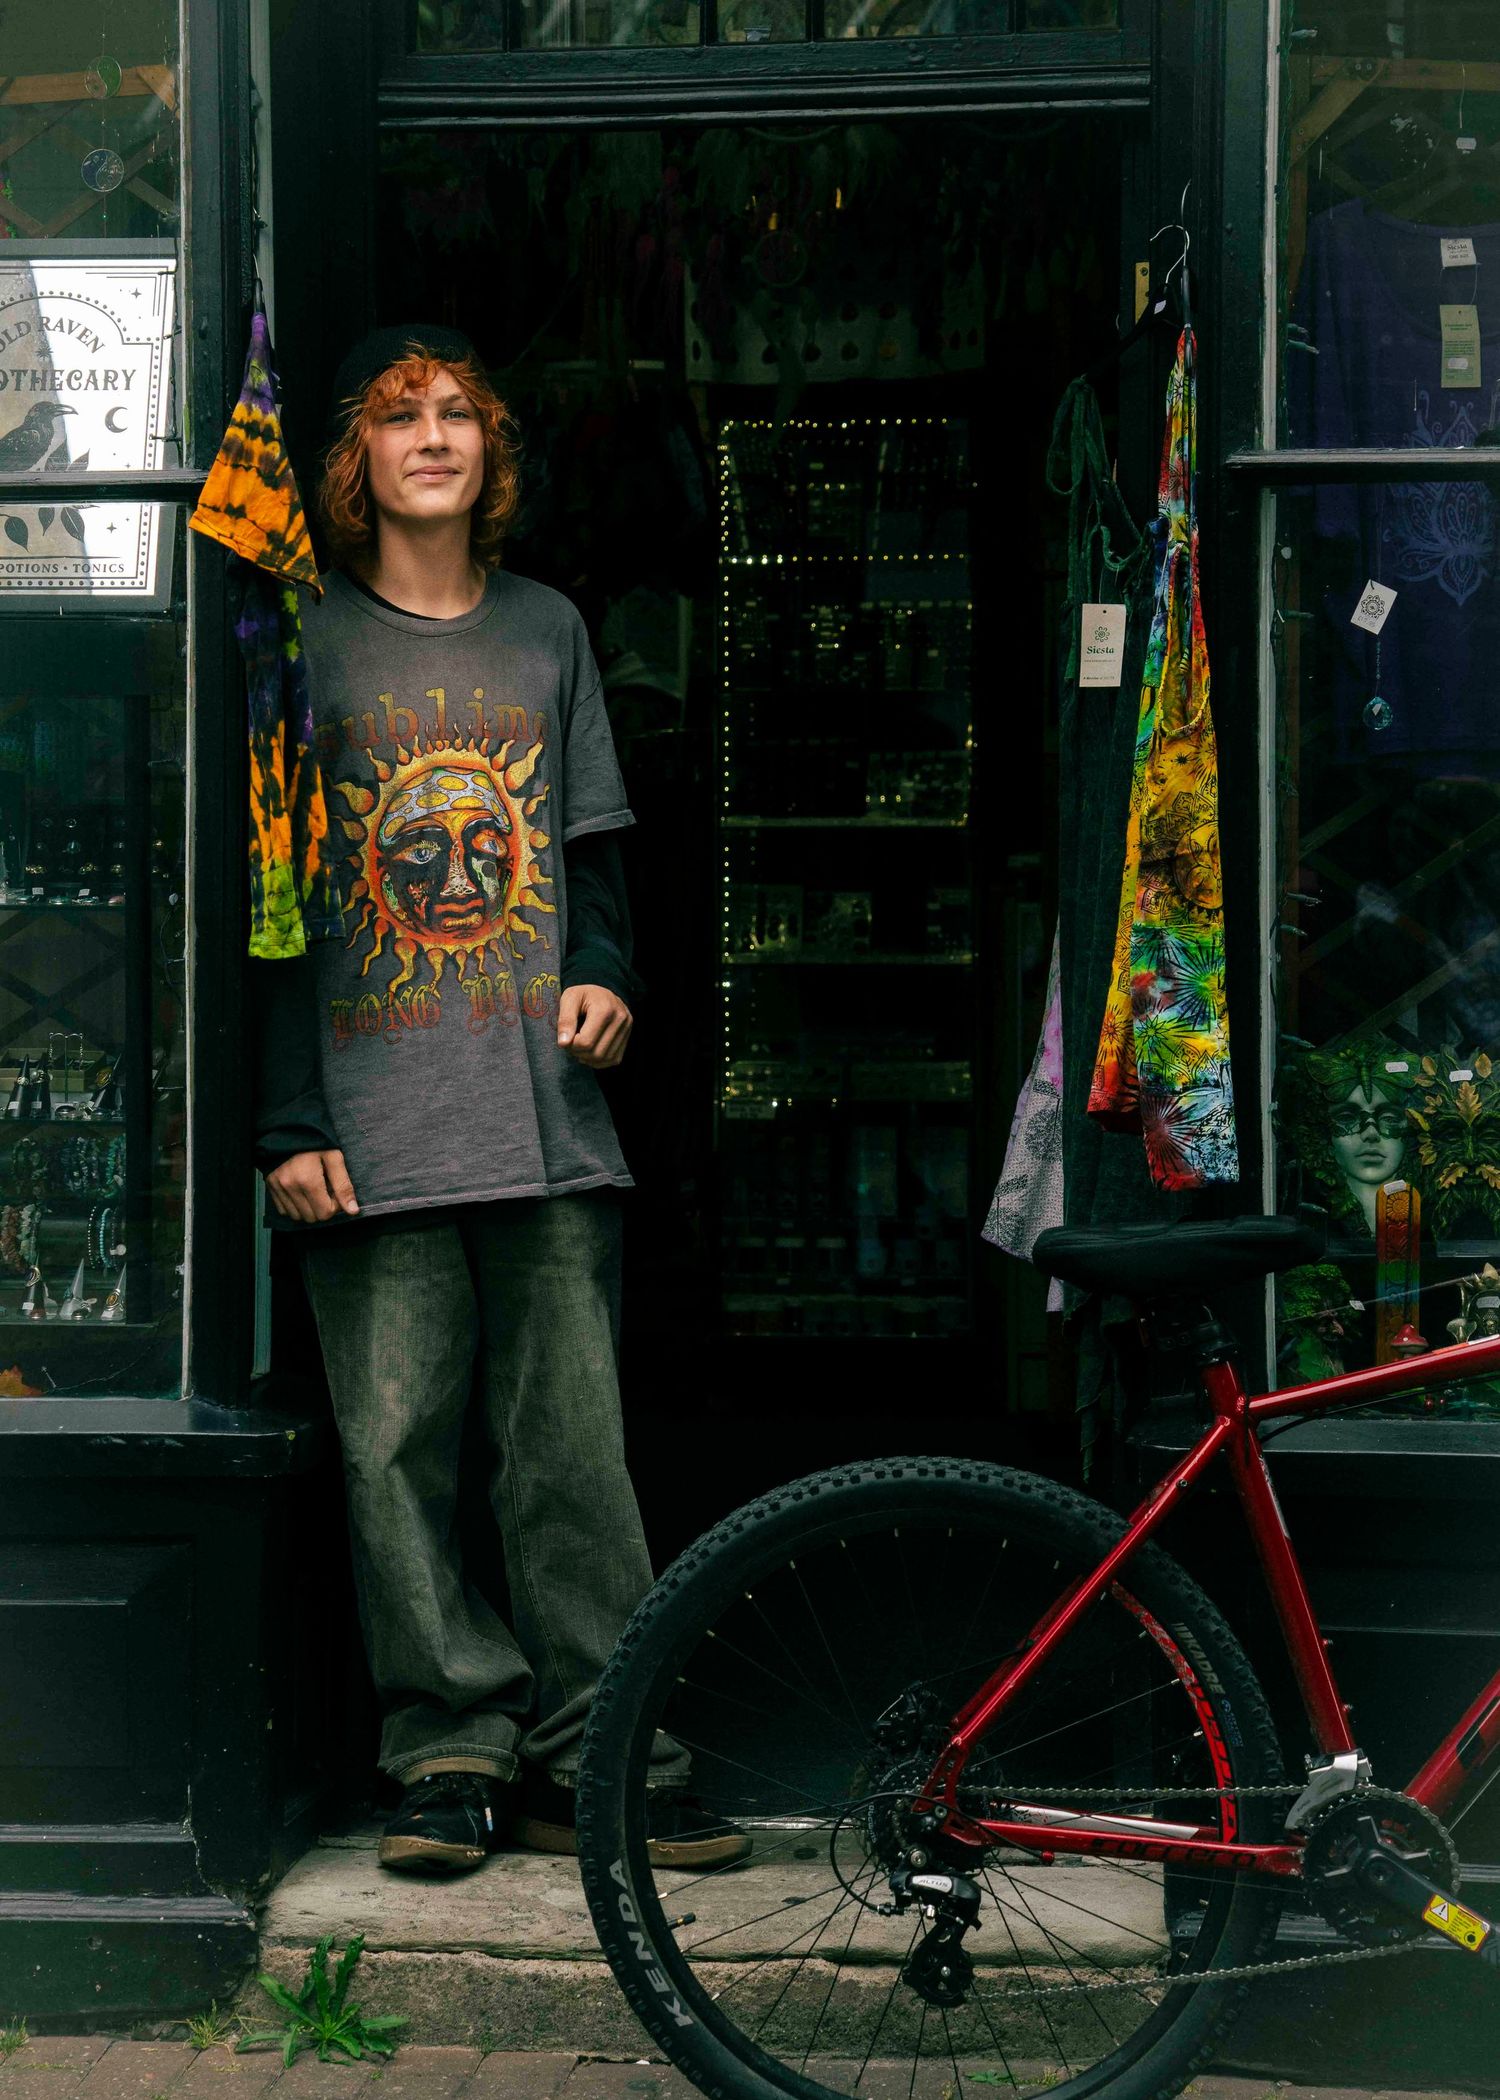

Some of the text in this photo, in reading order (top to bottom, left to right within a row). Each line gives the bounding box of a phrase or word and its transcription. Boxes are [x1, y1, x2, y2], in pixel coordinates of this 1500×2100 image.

[38, 316, 106, 354] RAVEN
[72, 563, 125, 573] TONICS
[1086, 645, 1115, 655] Siesta
[609, 1858, 694, 2027] KENDA
